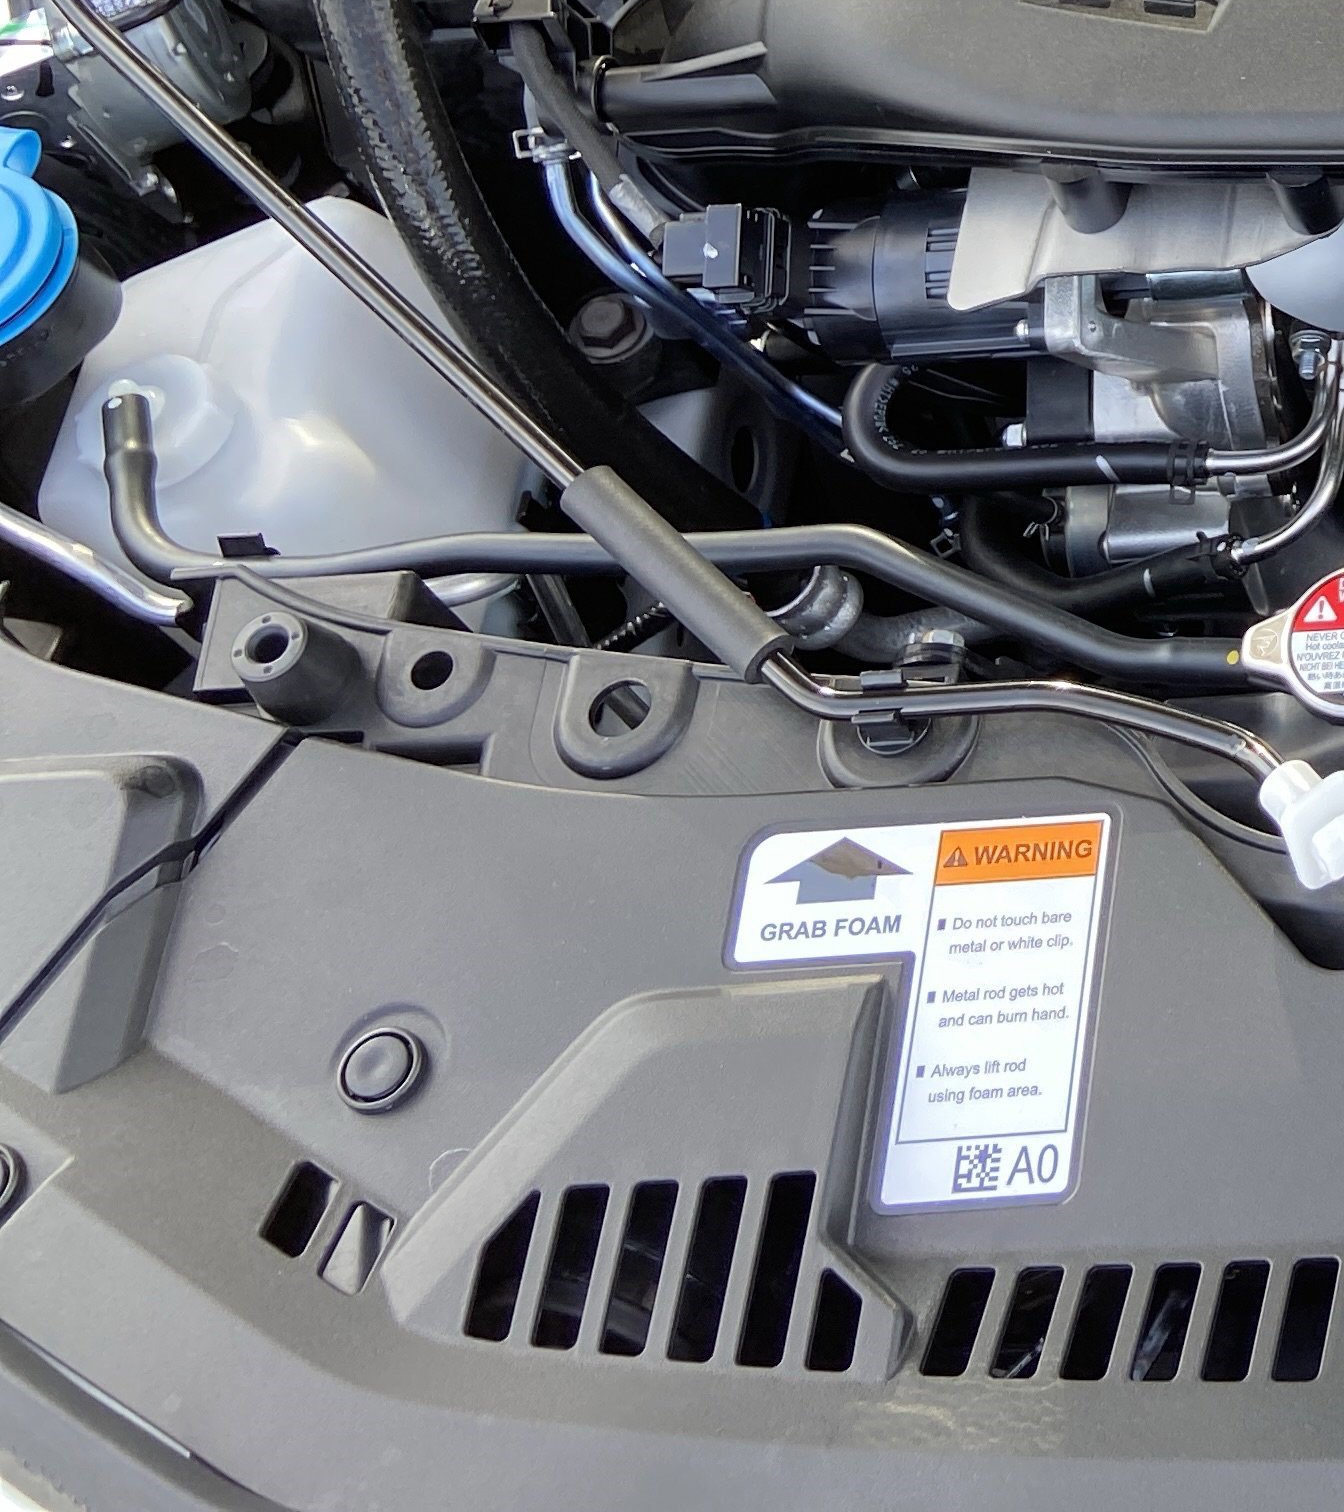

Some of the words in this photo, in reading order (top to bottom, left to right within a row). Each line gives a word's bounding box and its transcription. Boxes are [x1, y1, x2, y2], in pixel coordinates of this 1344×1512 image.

[1305, 641, 1320, 651] Hot
[1306, 632, 1338, 642] NEVER
[1300, 661, 1320, 671] NICHT
[973, 839, 1093, 866] WARNING
[760, 919, 827, 942] GRAB
[833, 914, 902, 937] FOAM
[952, 917, 972, 930] Do
[976, 914, 997, 929] not
[1000, 912, 1038, 927] touch
[1041, 911, 1072, 924] bare
[949, 939, 986, 954] metal
[990, 941, 1005, 951] or
[1007, 936, 1043, 951] white
[1046, 934, 1073, 950] clip.
[942, 987, 980, 1003] Metal
[983, 985, 1007, 1000] rod
[1009, 985, 1038, 1002] gets
[1042, 982, 1065, 996] hot
[938, 1013, 964, 1028] and
[968, 1014, 993, 1025] can
[996, 1010, 1028, 1023] burn
[1031, 1006, 1069, 1021] hand.
[930, 1063, 981, 1079] Always
[984, 1060, 1000, 1074] lift
[1003, 1058, 1027, 1073] rod
[928, 1088, 965, 1105] using
[968, 1086, 1003, 1101] foam
[1006, 1085, 1042, 1098] area.
[1005, 1143, 1060, 1186] A0
